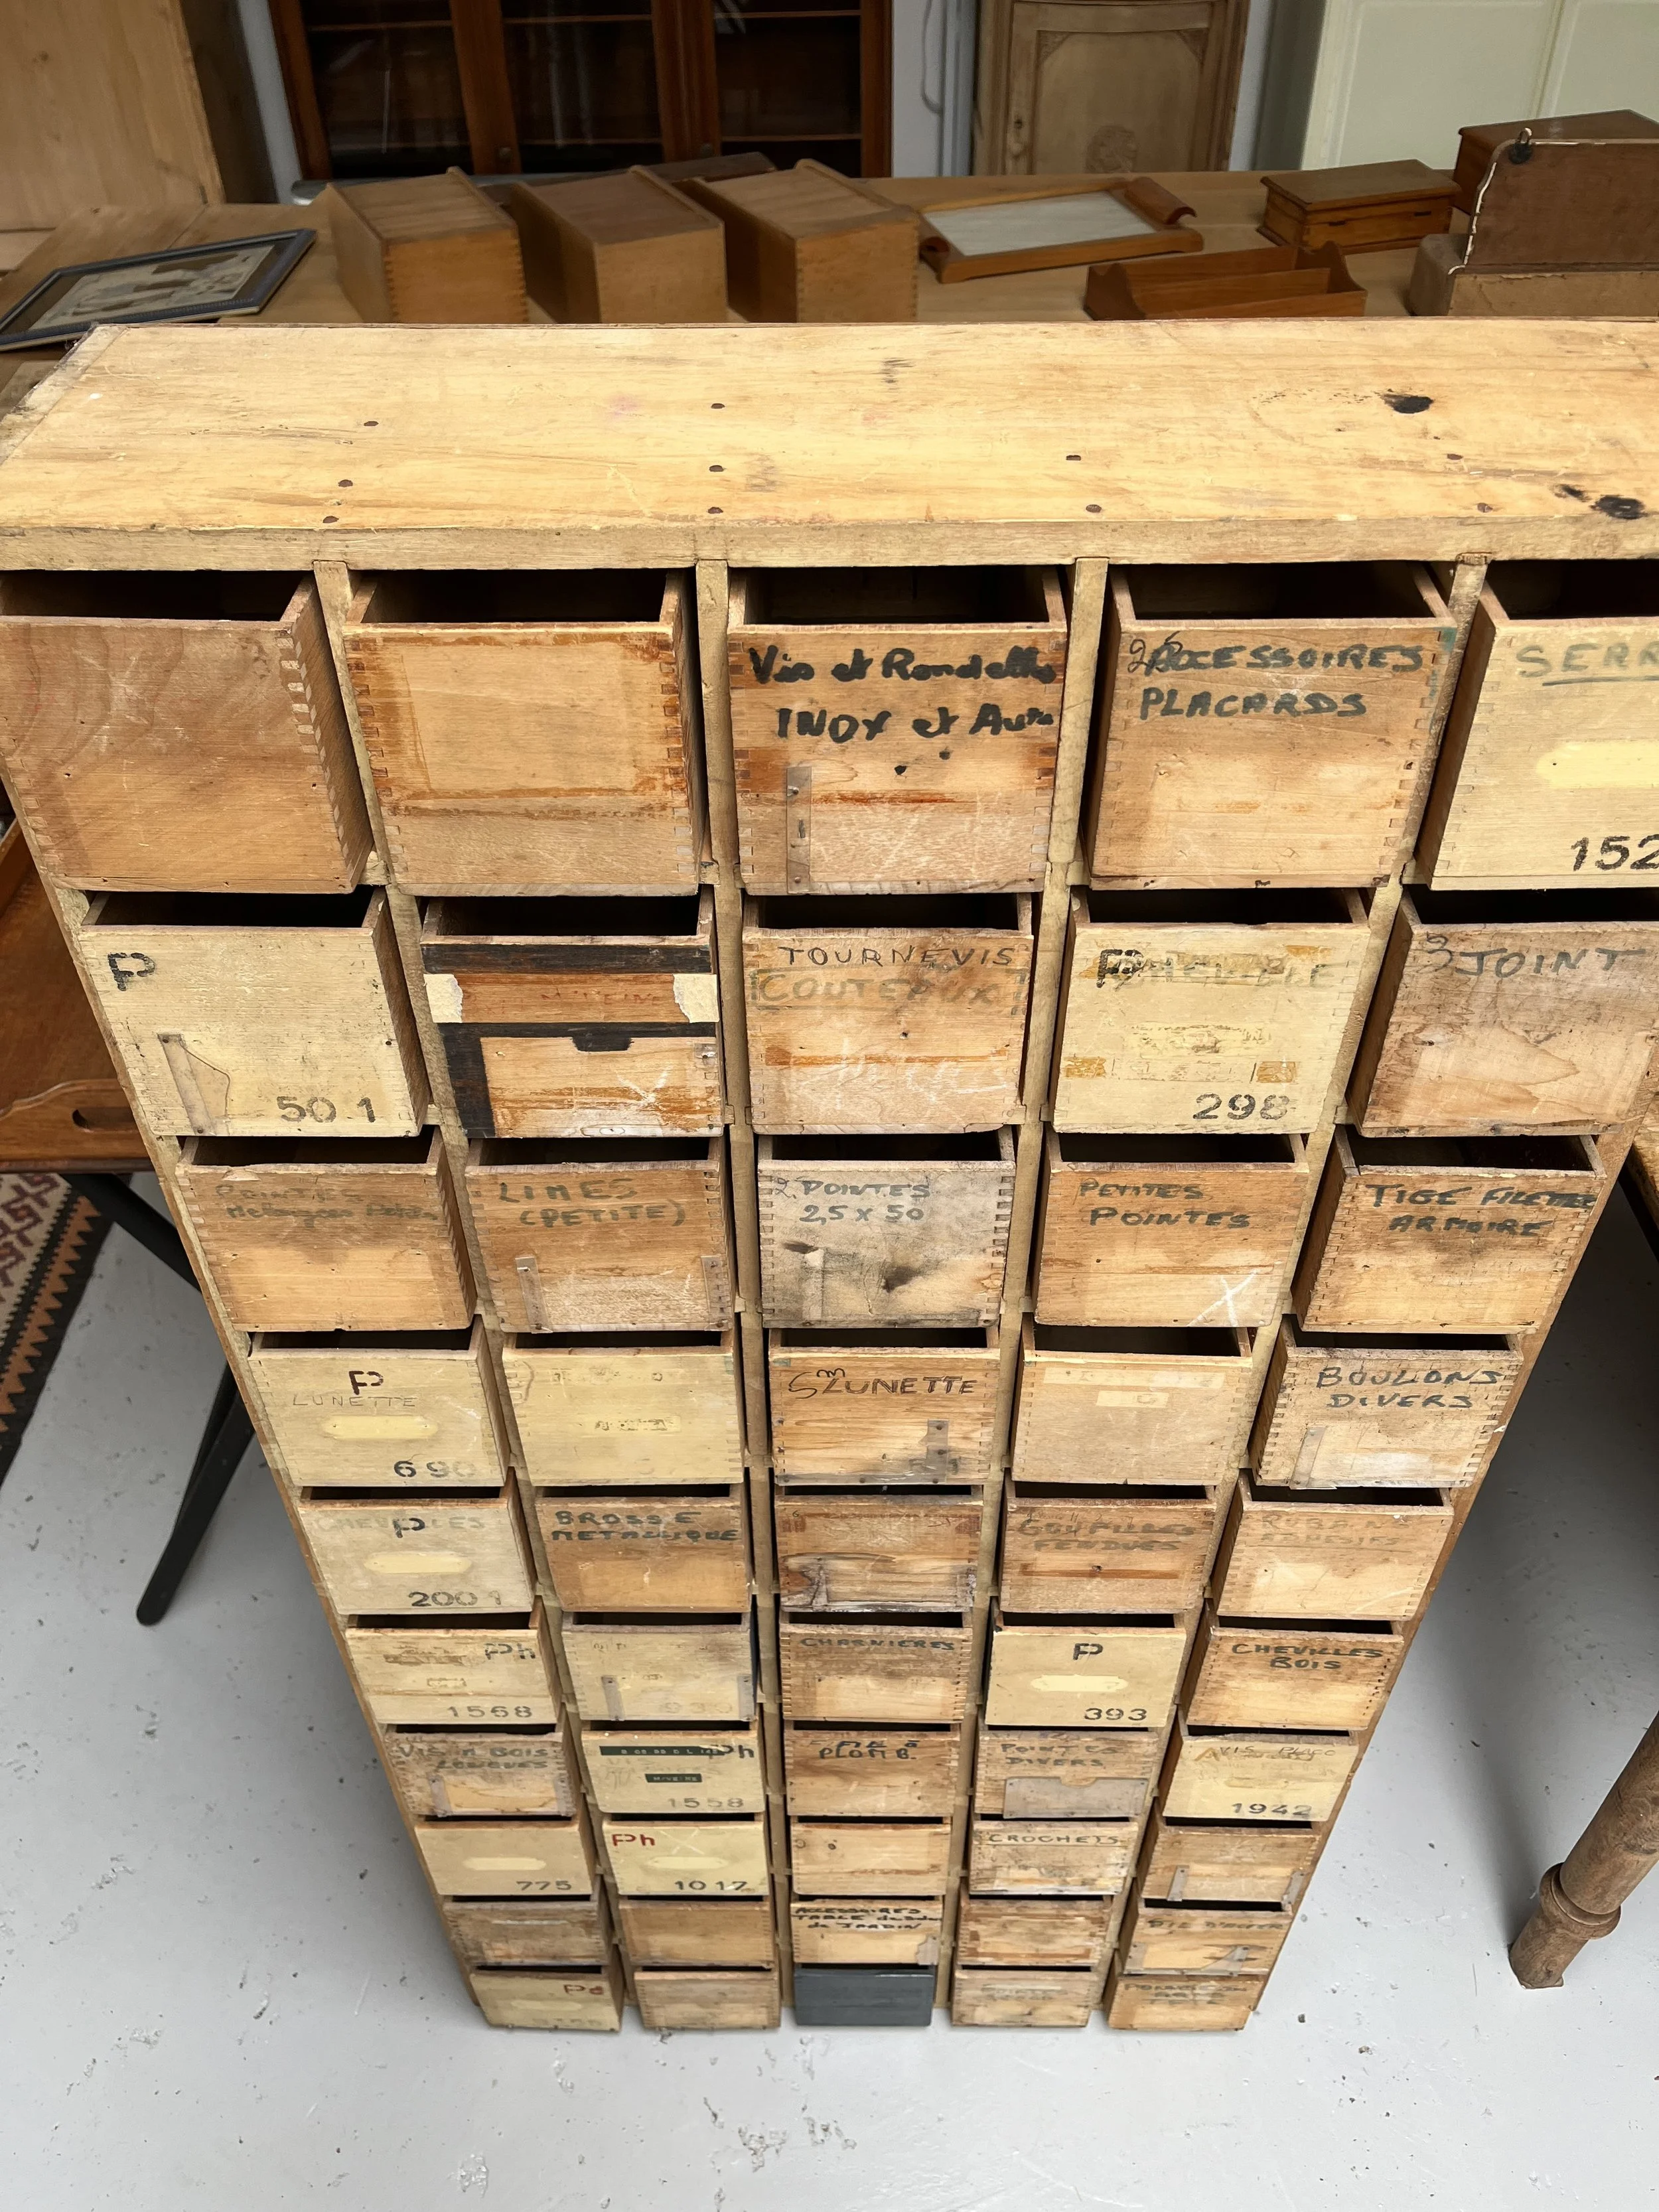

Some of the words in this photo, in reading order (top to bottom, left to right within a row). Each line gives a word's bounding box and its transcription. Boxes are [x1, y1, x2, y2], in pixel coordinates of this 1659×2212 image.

[1139, 687, 1367, 720] PLACARDS
[777, 706, 892, 743] INOX
[912, 706, 959, 737] et
[778, 945, 1015, 967] TOURNEVIS
[1455, 948, 1646, 978] JOINT
[108, 952, 157, 992] P
[1193, 1094, 1289, 1120] 298
[499, 1178, 638, 1203] LIMES
[796, 1179, 930, 1197] POINTES
[1075, 1178, 1204, 1200] PETITES
[1365, 1183, 1472, 1207] TIGE
[520, 1199, 685, 1228] (PETITE)
[885, 1205, 924, 1221] 50
[1090, 1207, 1251, 1229] POINTES
[1390, 1215, 1553, 1236] ARMOIRE
[349, 1370, 384, 1394] P
[822, 1376, 977, 1394] LUNETTE
[1317, 1367, 1503, 1388] BOULONS
[293, 1396, 417, 1407] LUNETTE
[1327, 1394, 1473, 1408] DIVERS
[555, 1511, 701, 1524] BROSSE
[800, 1638, 955, 1650] CHARNIERES
[1072, 1643, 1104, 1660] P
[1232, 1644, 1383, 1657] CHEVILLES
[1270, 1657, 1341, 1669] BOIS
[449, 1706, 532, 1718] 1568
[1084, 1708, 1147, 1721] 393
[1005, 1757, 1103, 1766] DIVERS
[1232, 1803, 1313, 1816] 1942
[612, 1834, 656, 1847] Ph
[989, 1834, 1119, 1844] CROCHETS
[516, 1880, 572, 1891] 775
[675, 1881, 748, 1891] 1017
